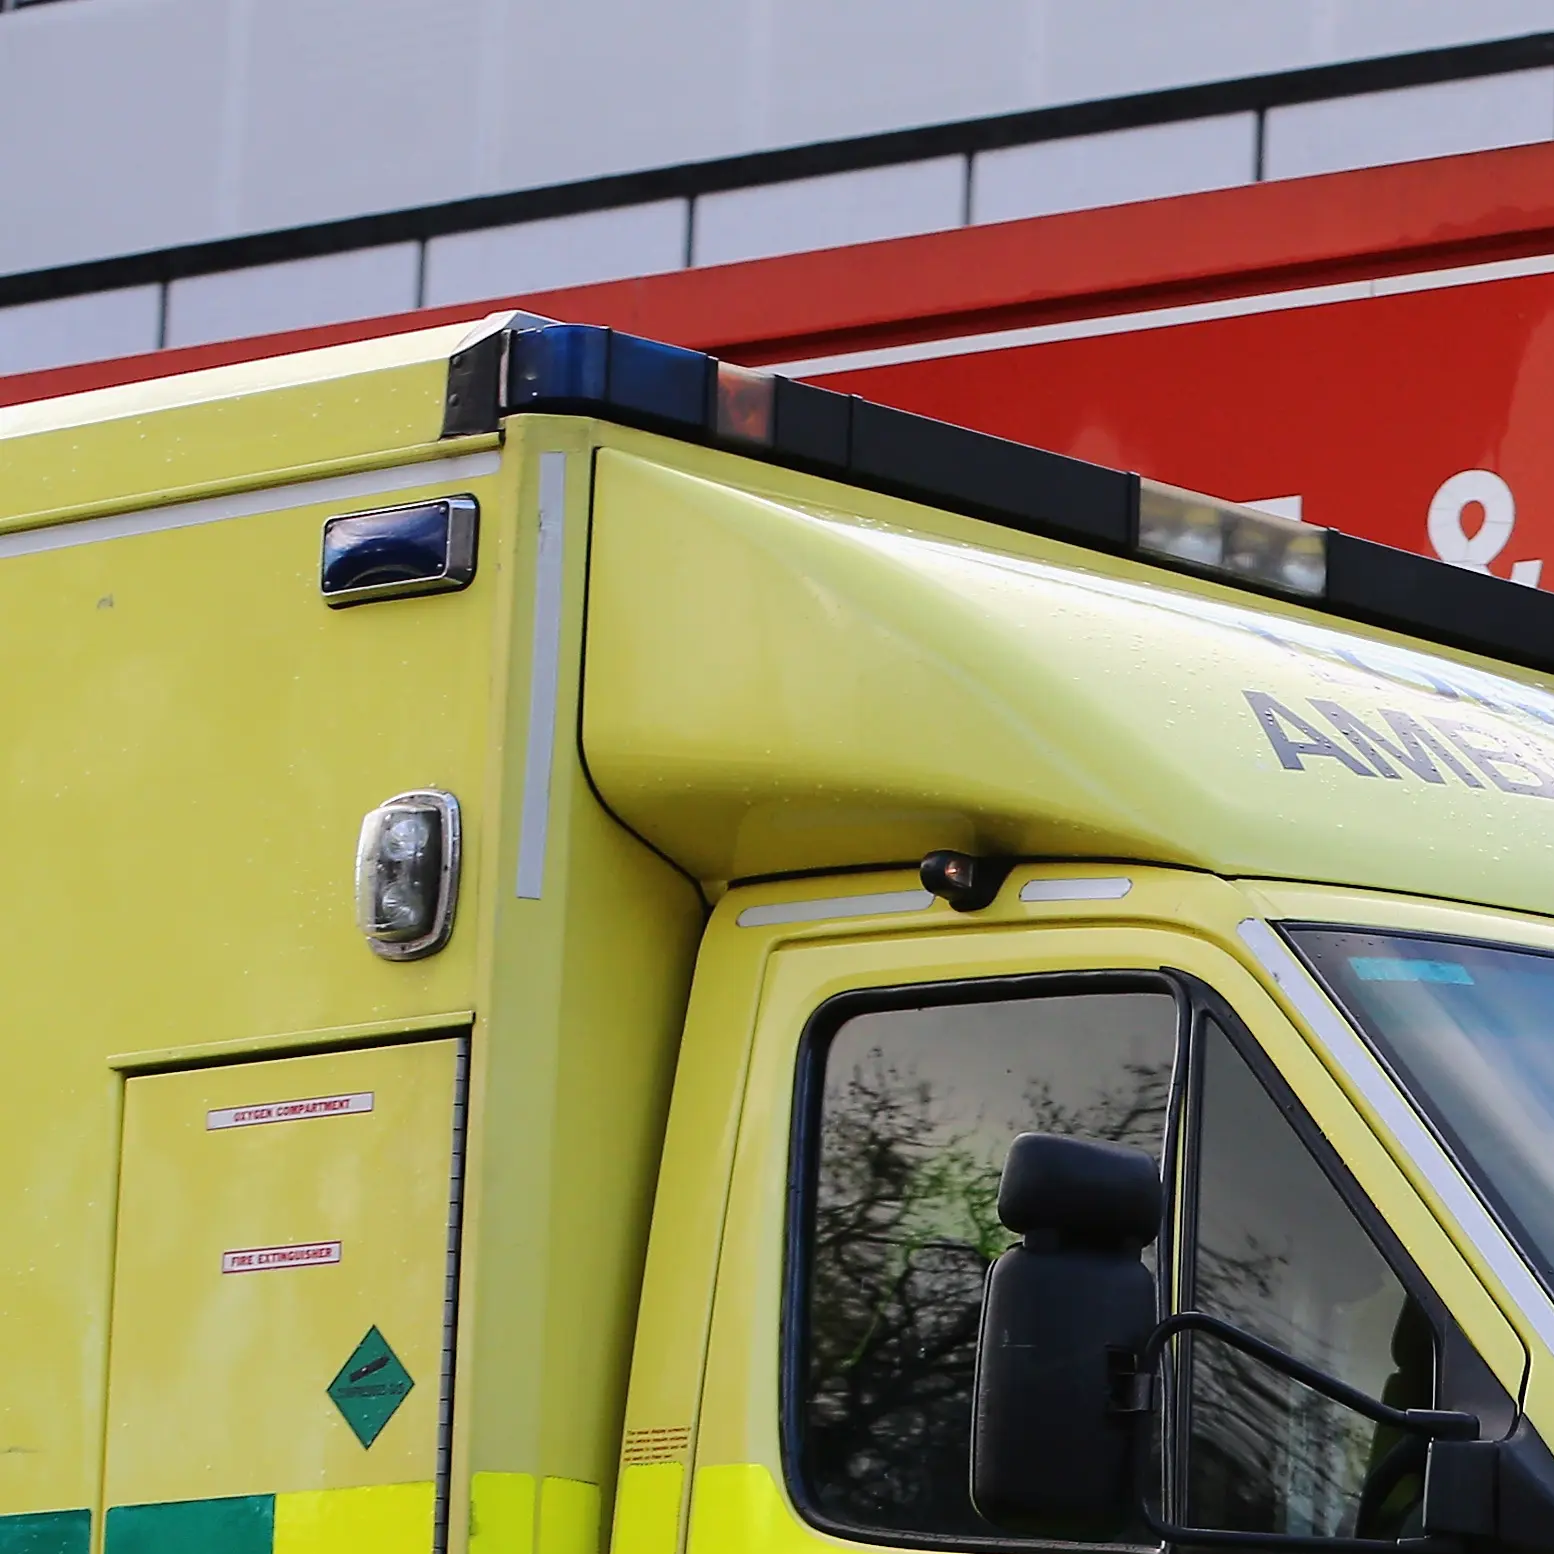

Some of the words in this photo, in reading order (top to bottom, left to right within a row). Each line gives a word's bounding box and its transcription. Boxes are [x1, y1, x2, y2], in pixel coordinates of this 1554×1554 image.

[232, 1108, 273, 1122] OXYGEN
[276, 1099, 351, 1117] COMPARTMENT
[231, 1255, 253, 1267] FIRE
[258, 1247, 332, 1264] EXTINGUISHER
